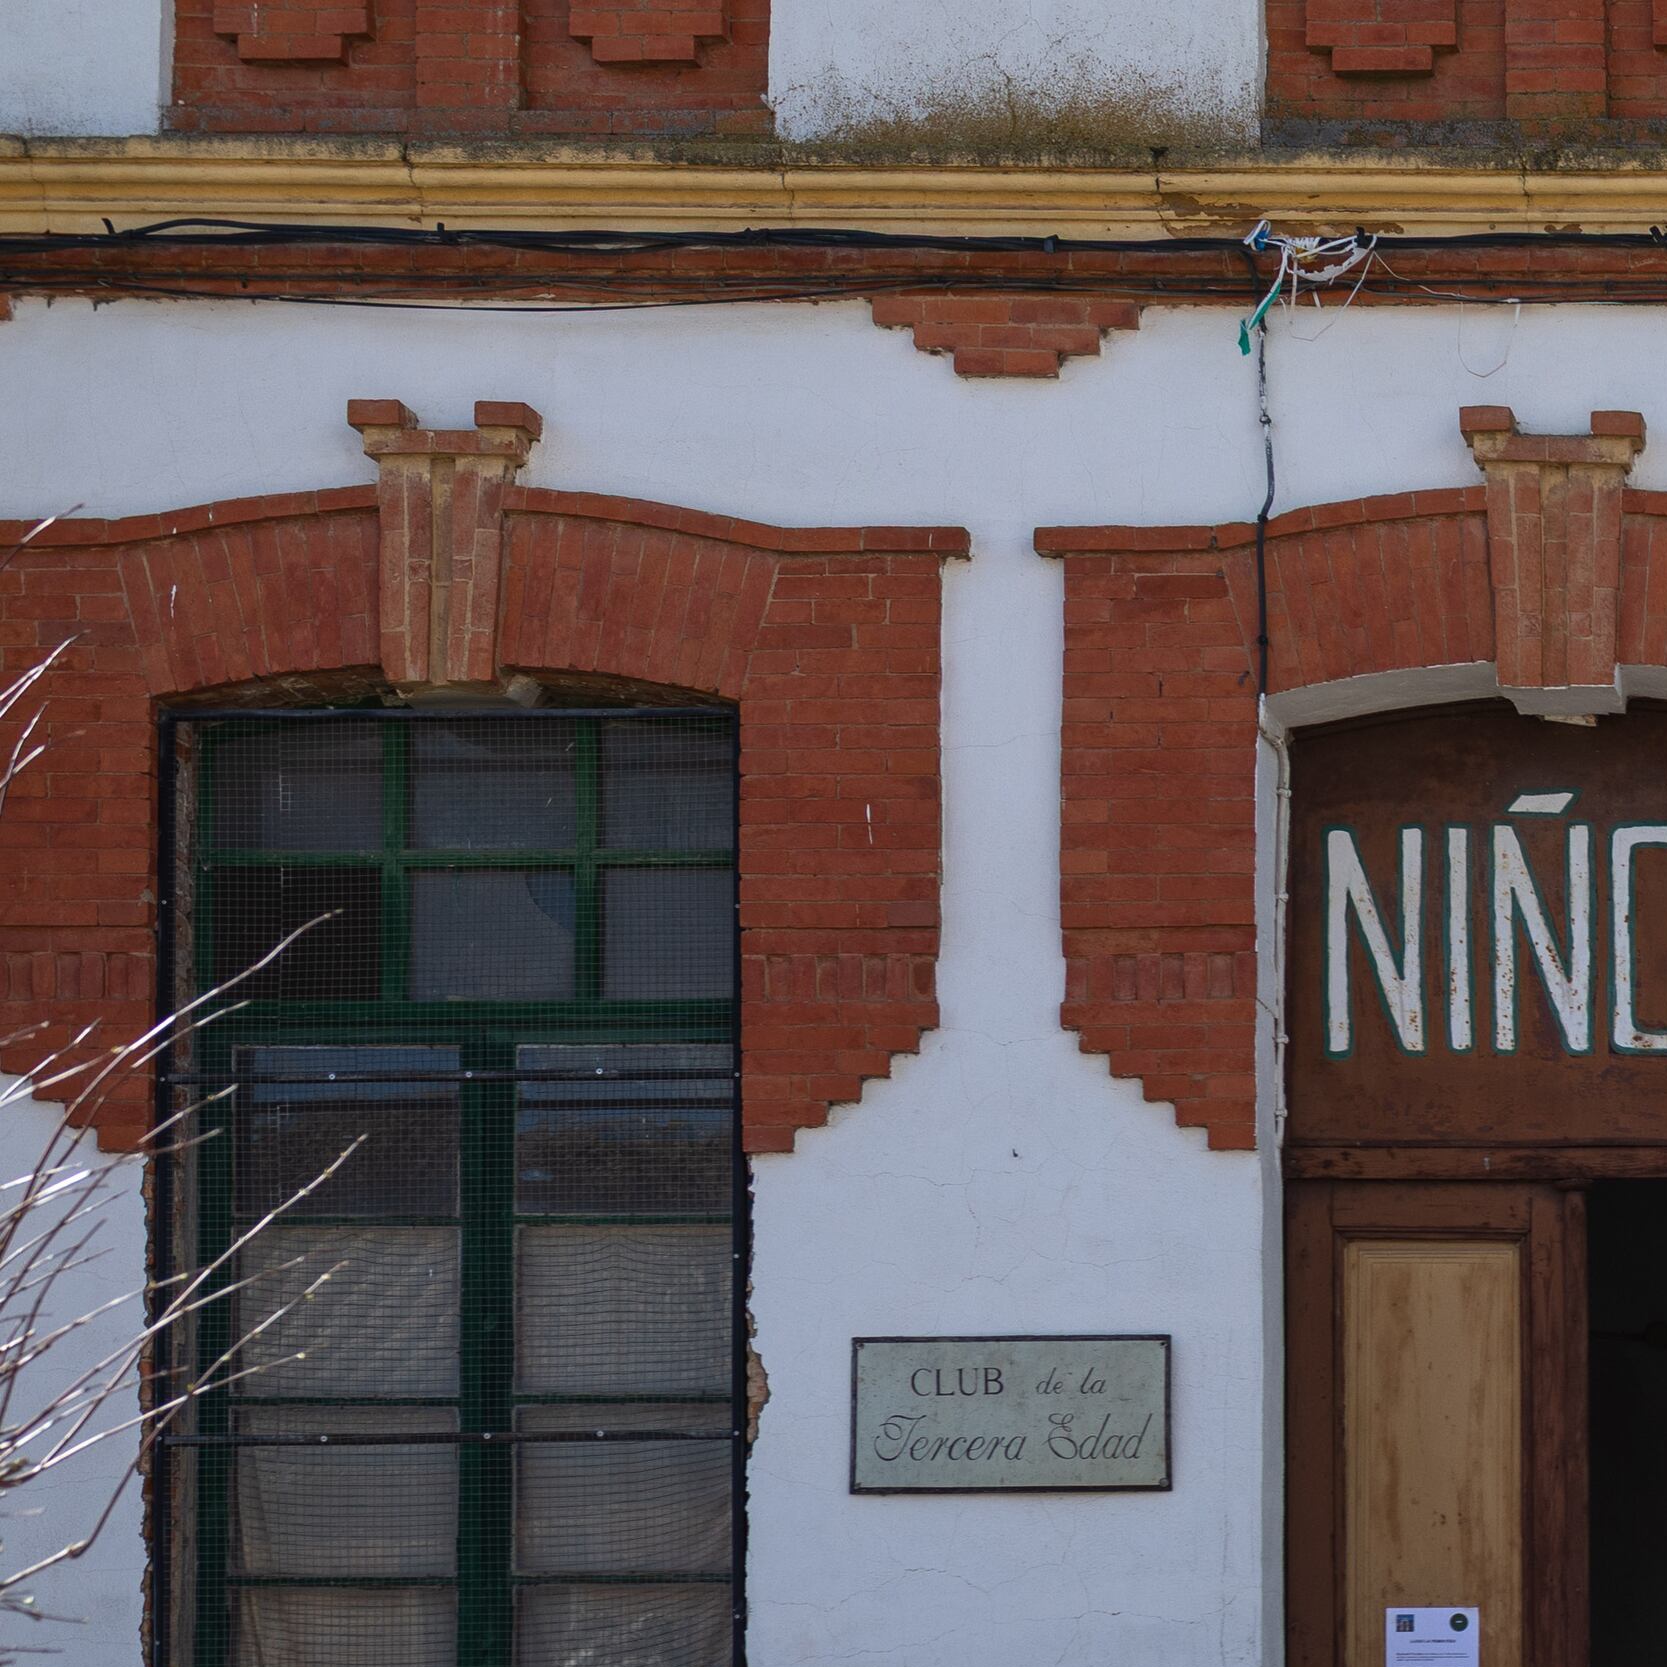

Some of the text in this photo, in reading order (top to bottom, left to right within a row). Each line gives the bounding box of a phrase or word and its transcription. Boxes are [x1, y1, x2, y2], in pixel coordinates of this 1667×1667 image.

[911, 1367, 1107, 1396] CLUB de la
[874, 1412, 1153, 1462] Tercera Edad
